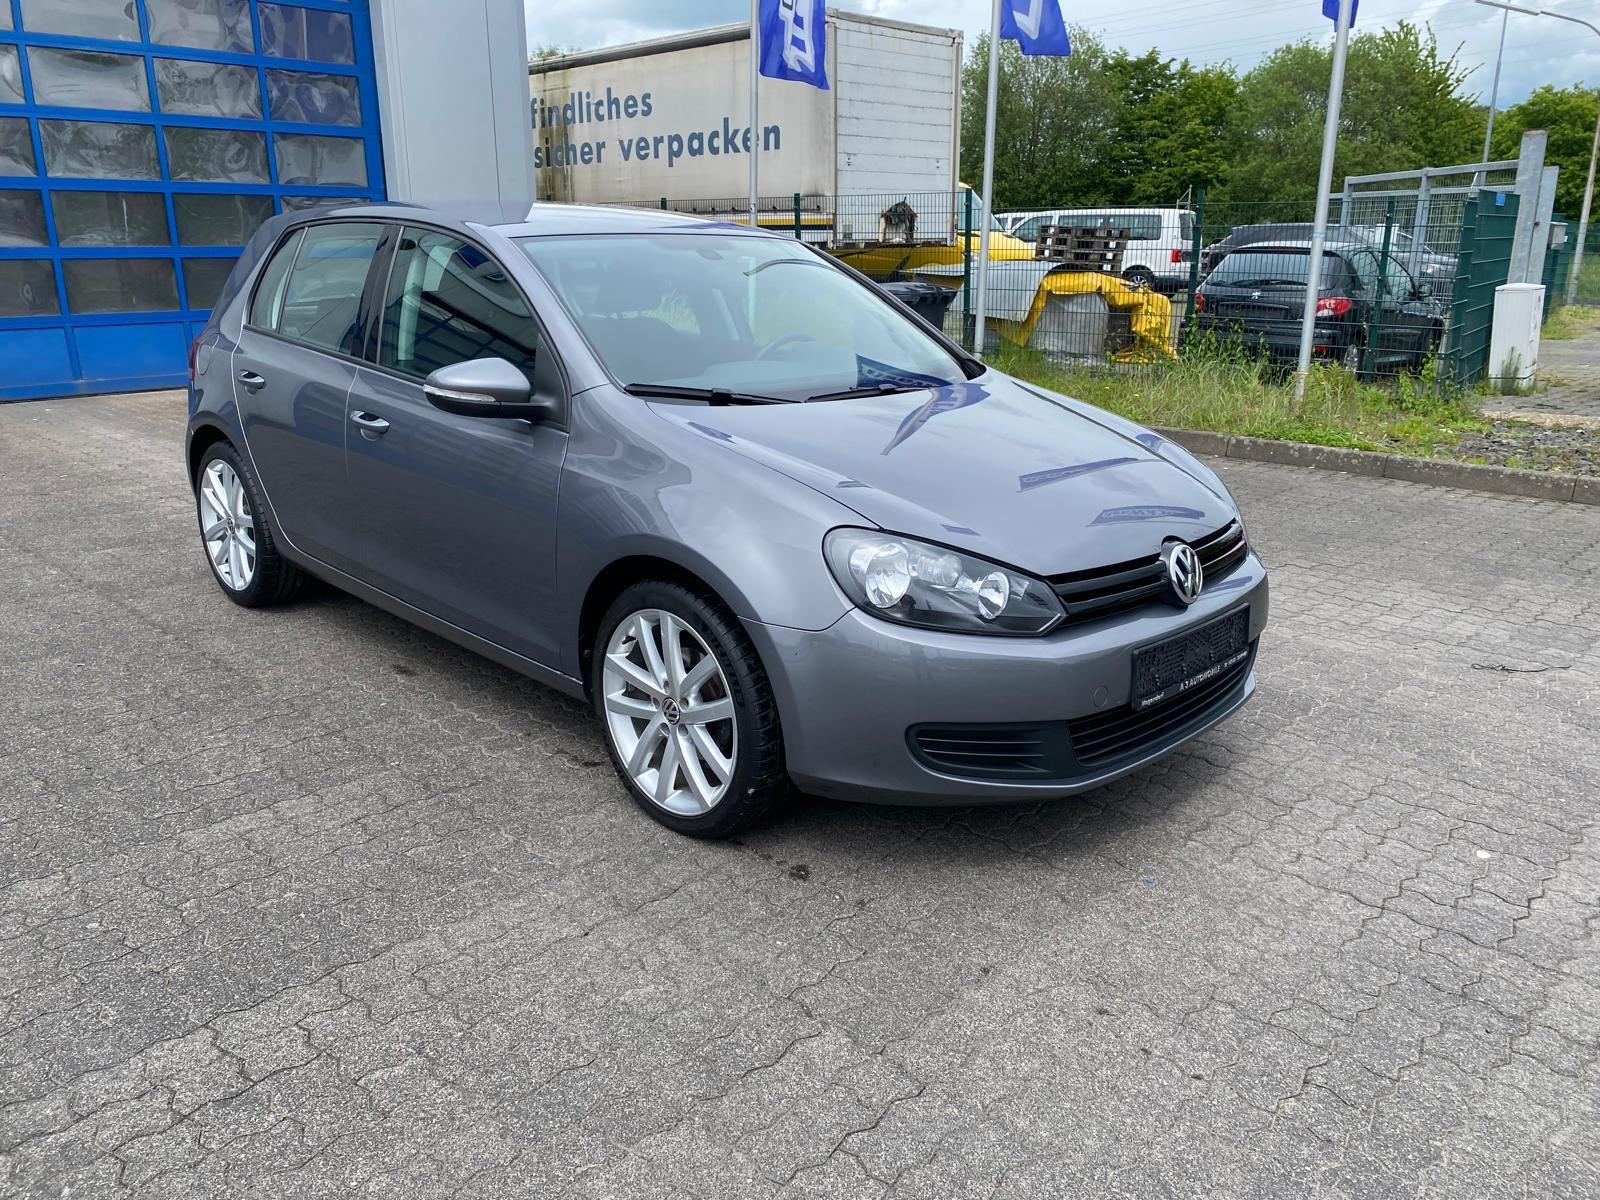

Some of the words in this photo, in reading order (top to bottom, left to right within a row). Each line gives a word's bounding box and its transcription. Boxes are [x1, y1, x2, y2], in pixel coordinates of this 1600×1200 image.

[530, 87, 653, 129] findliches
[534, 131, 606, 168] sicher
[1189, 664, 1221, 687] AUTOMOBILE
